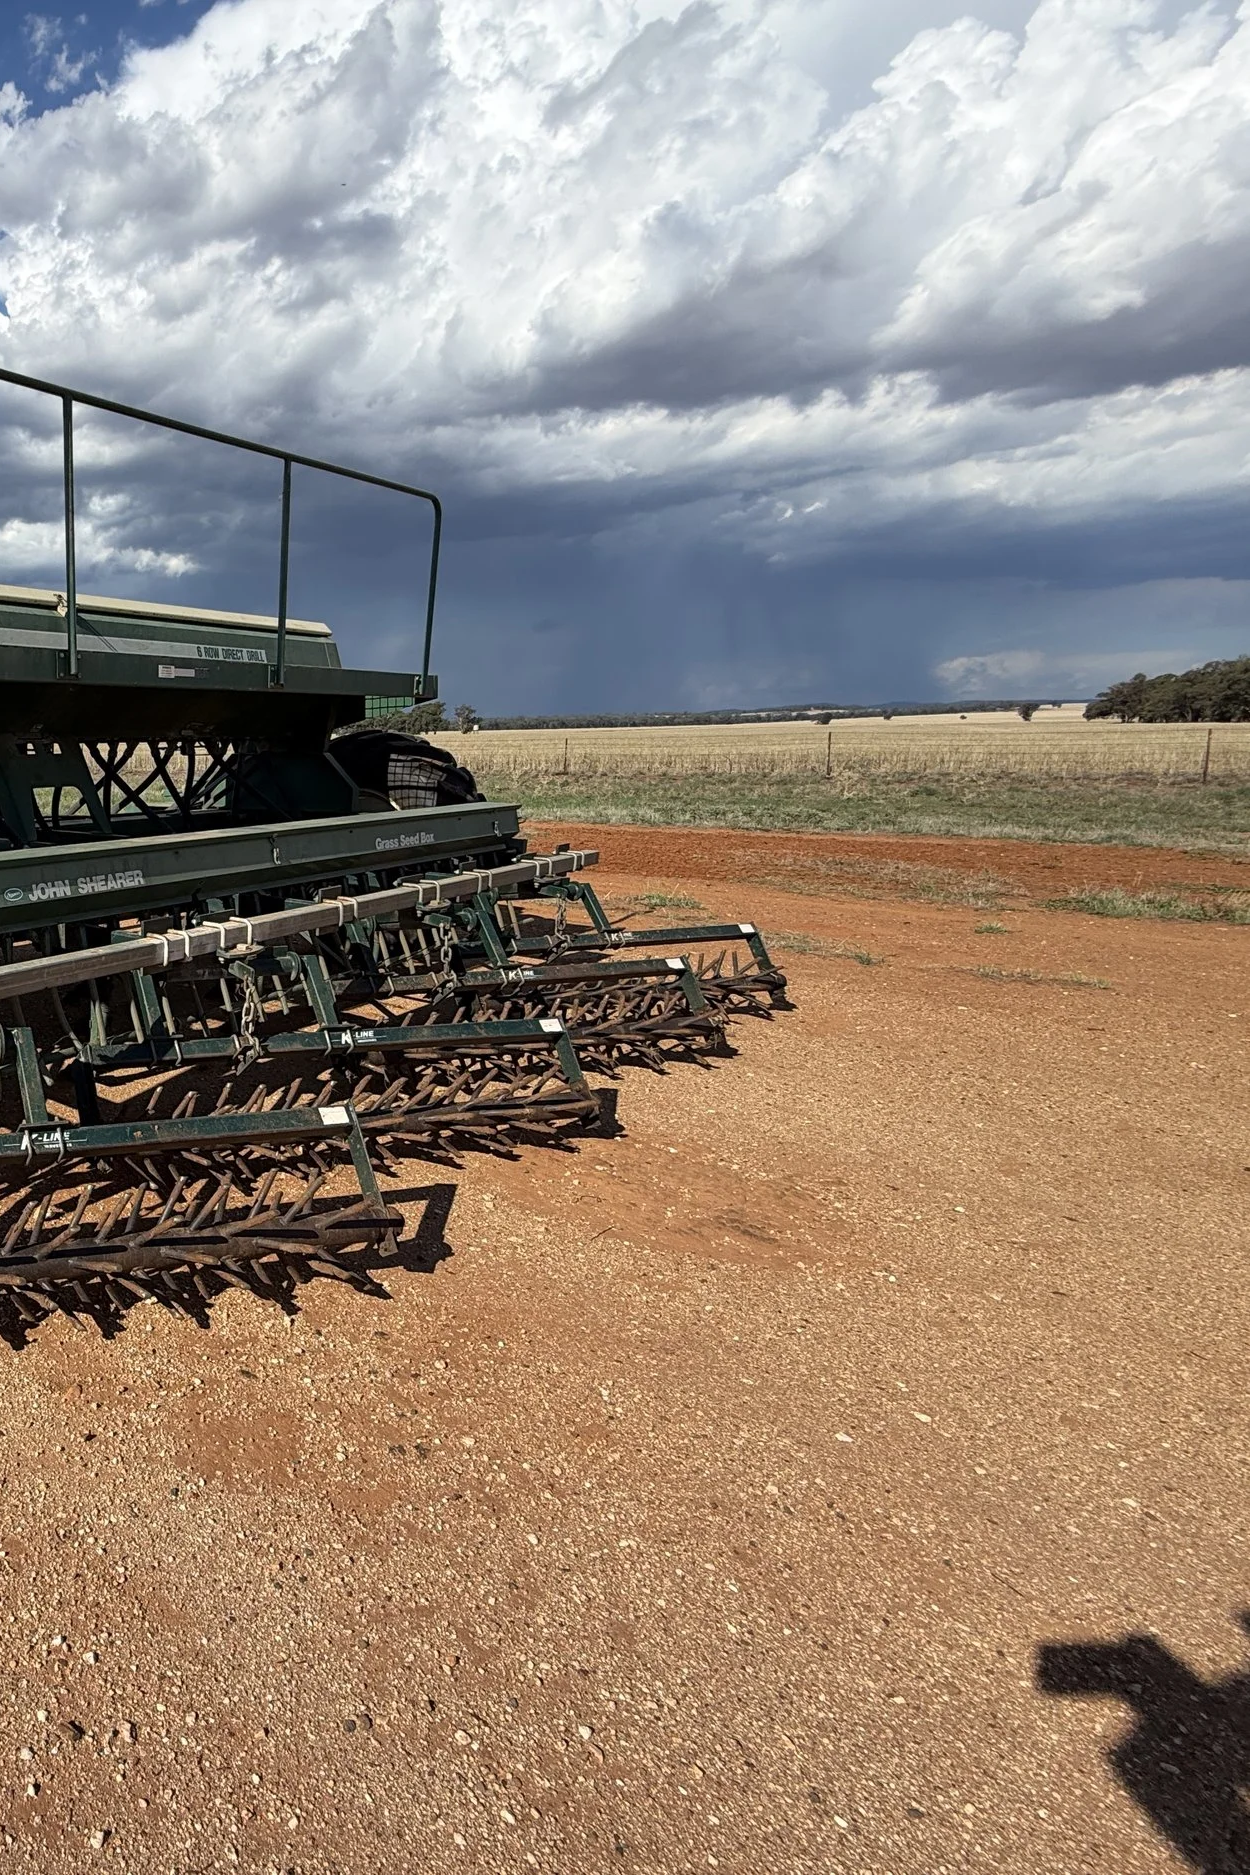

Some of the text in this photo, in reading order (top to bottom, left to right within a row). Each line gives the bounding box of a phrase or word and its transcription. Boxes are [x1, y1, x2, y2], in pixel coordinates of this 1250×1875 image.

[196, 645, 265, 663] 6 ROW DIRECT DRILL
[375, 831, 435, 850] Grass Seed Box
[28, 879, 72, 901] JOHN
[77, 869, 145, 895] SHEARER
